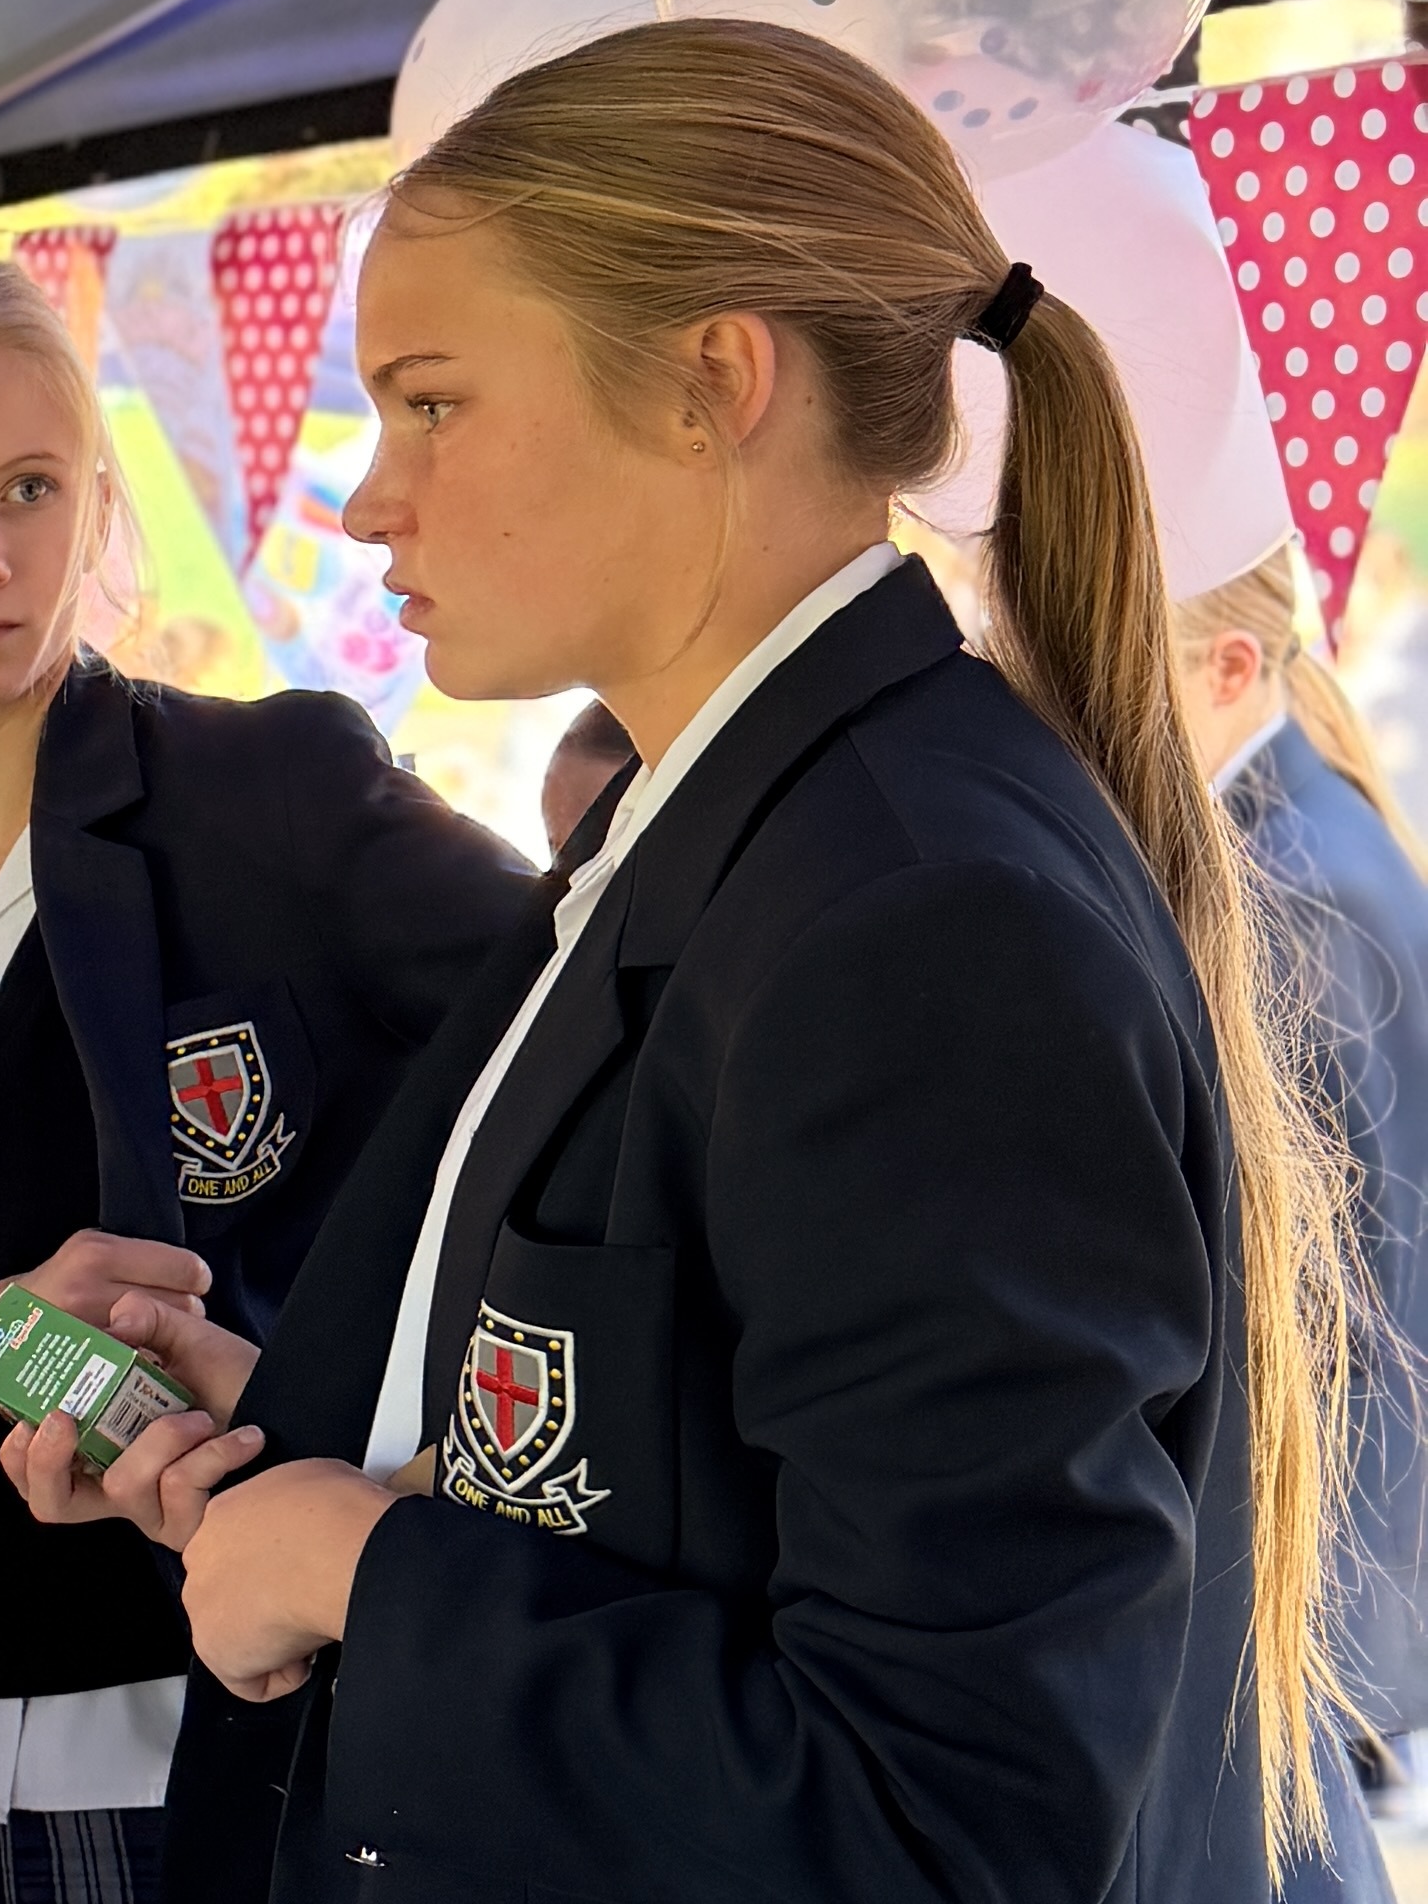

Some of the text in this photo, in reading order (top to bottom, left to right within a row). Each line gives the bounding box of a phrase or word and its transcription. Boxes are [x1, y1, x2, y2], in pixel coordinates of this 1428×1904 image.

[188, 1162, 272, 1196] ONE AND ALL
[455, 1477, 573, 1528] ONE AND ALL
